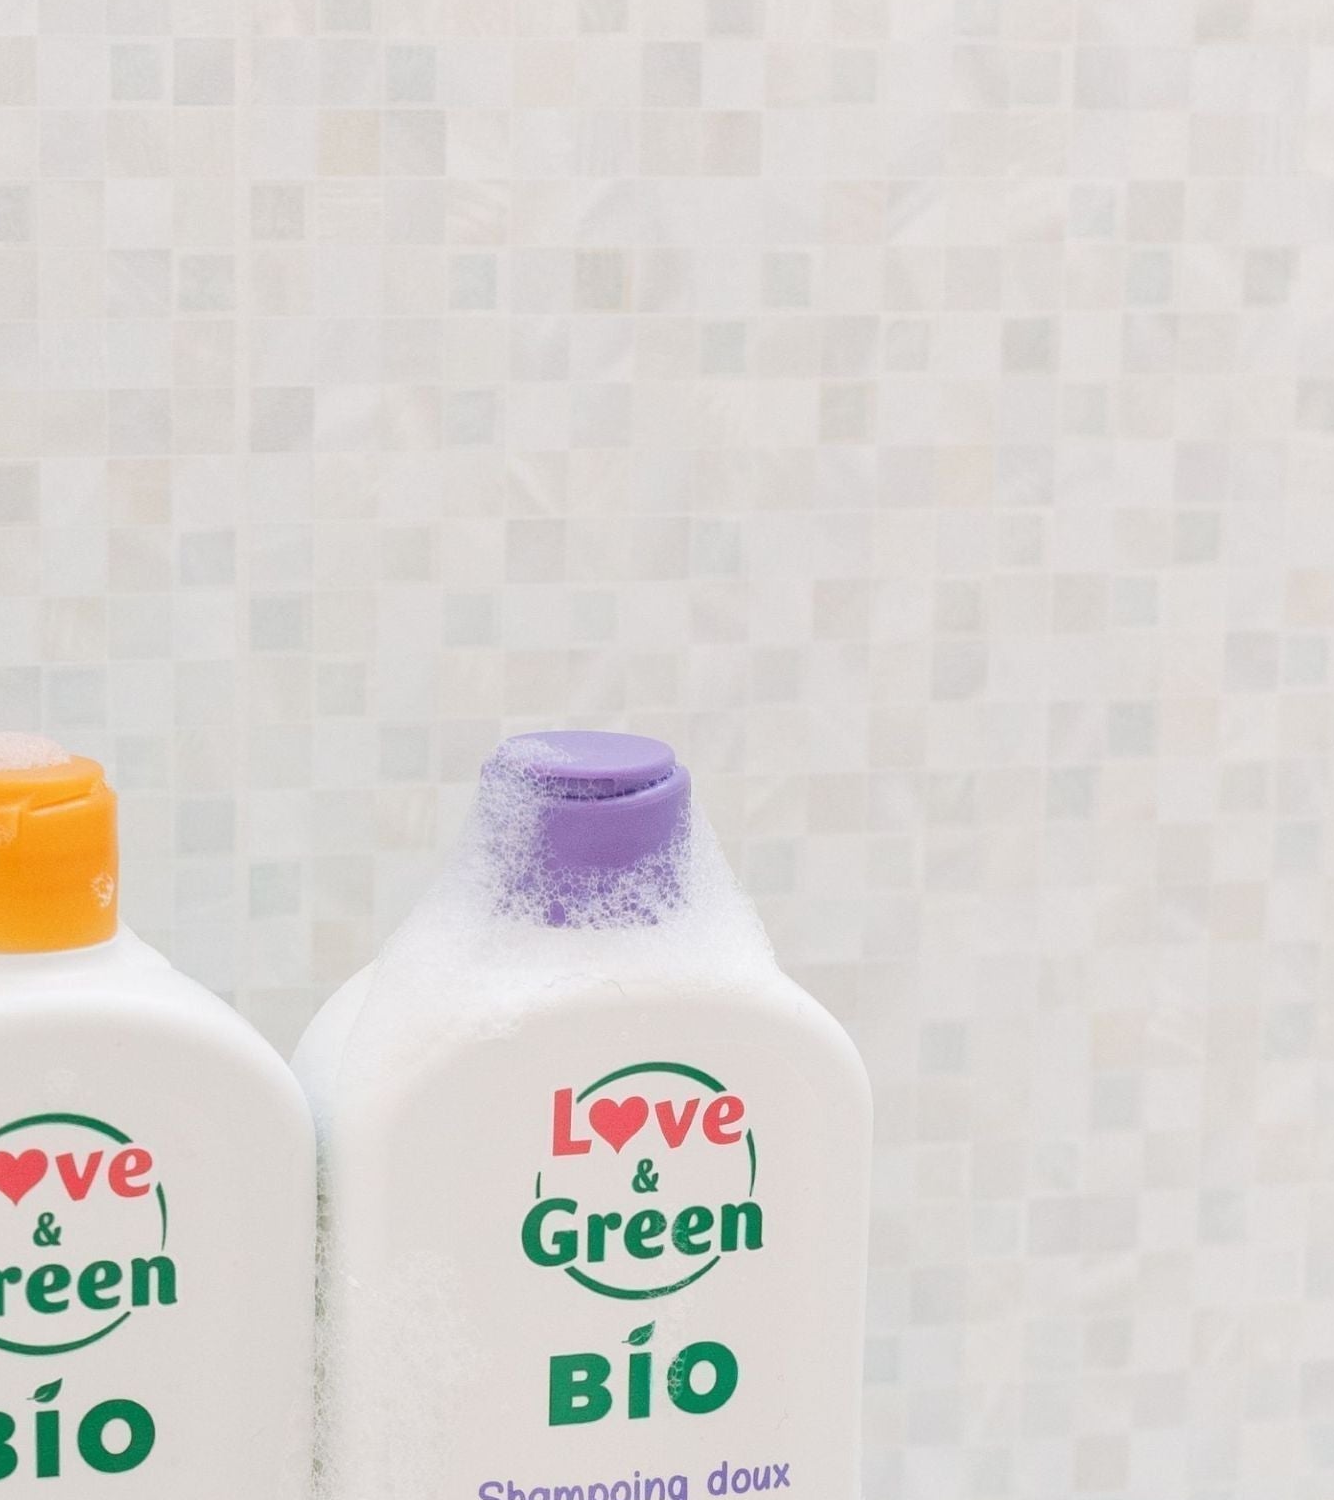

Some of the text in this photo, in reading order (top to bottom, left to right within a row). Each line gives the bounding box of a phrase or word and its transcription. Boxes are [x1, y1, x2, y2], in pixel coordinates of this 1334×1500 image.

[632, 1158, 659, 1193] &
[32, 1211, 62, 1247] &
[521, 1197, 763, 1267] Green
[707, 1461, 791, 1496] doux
